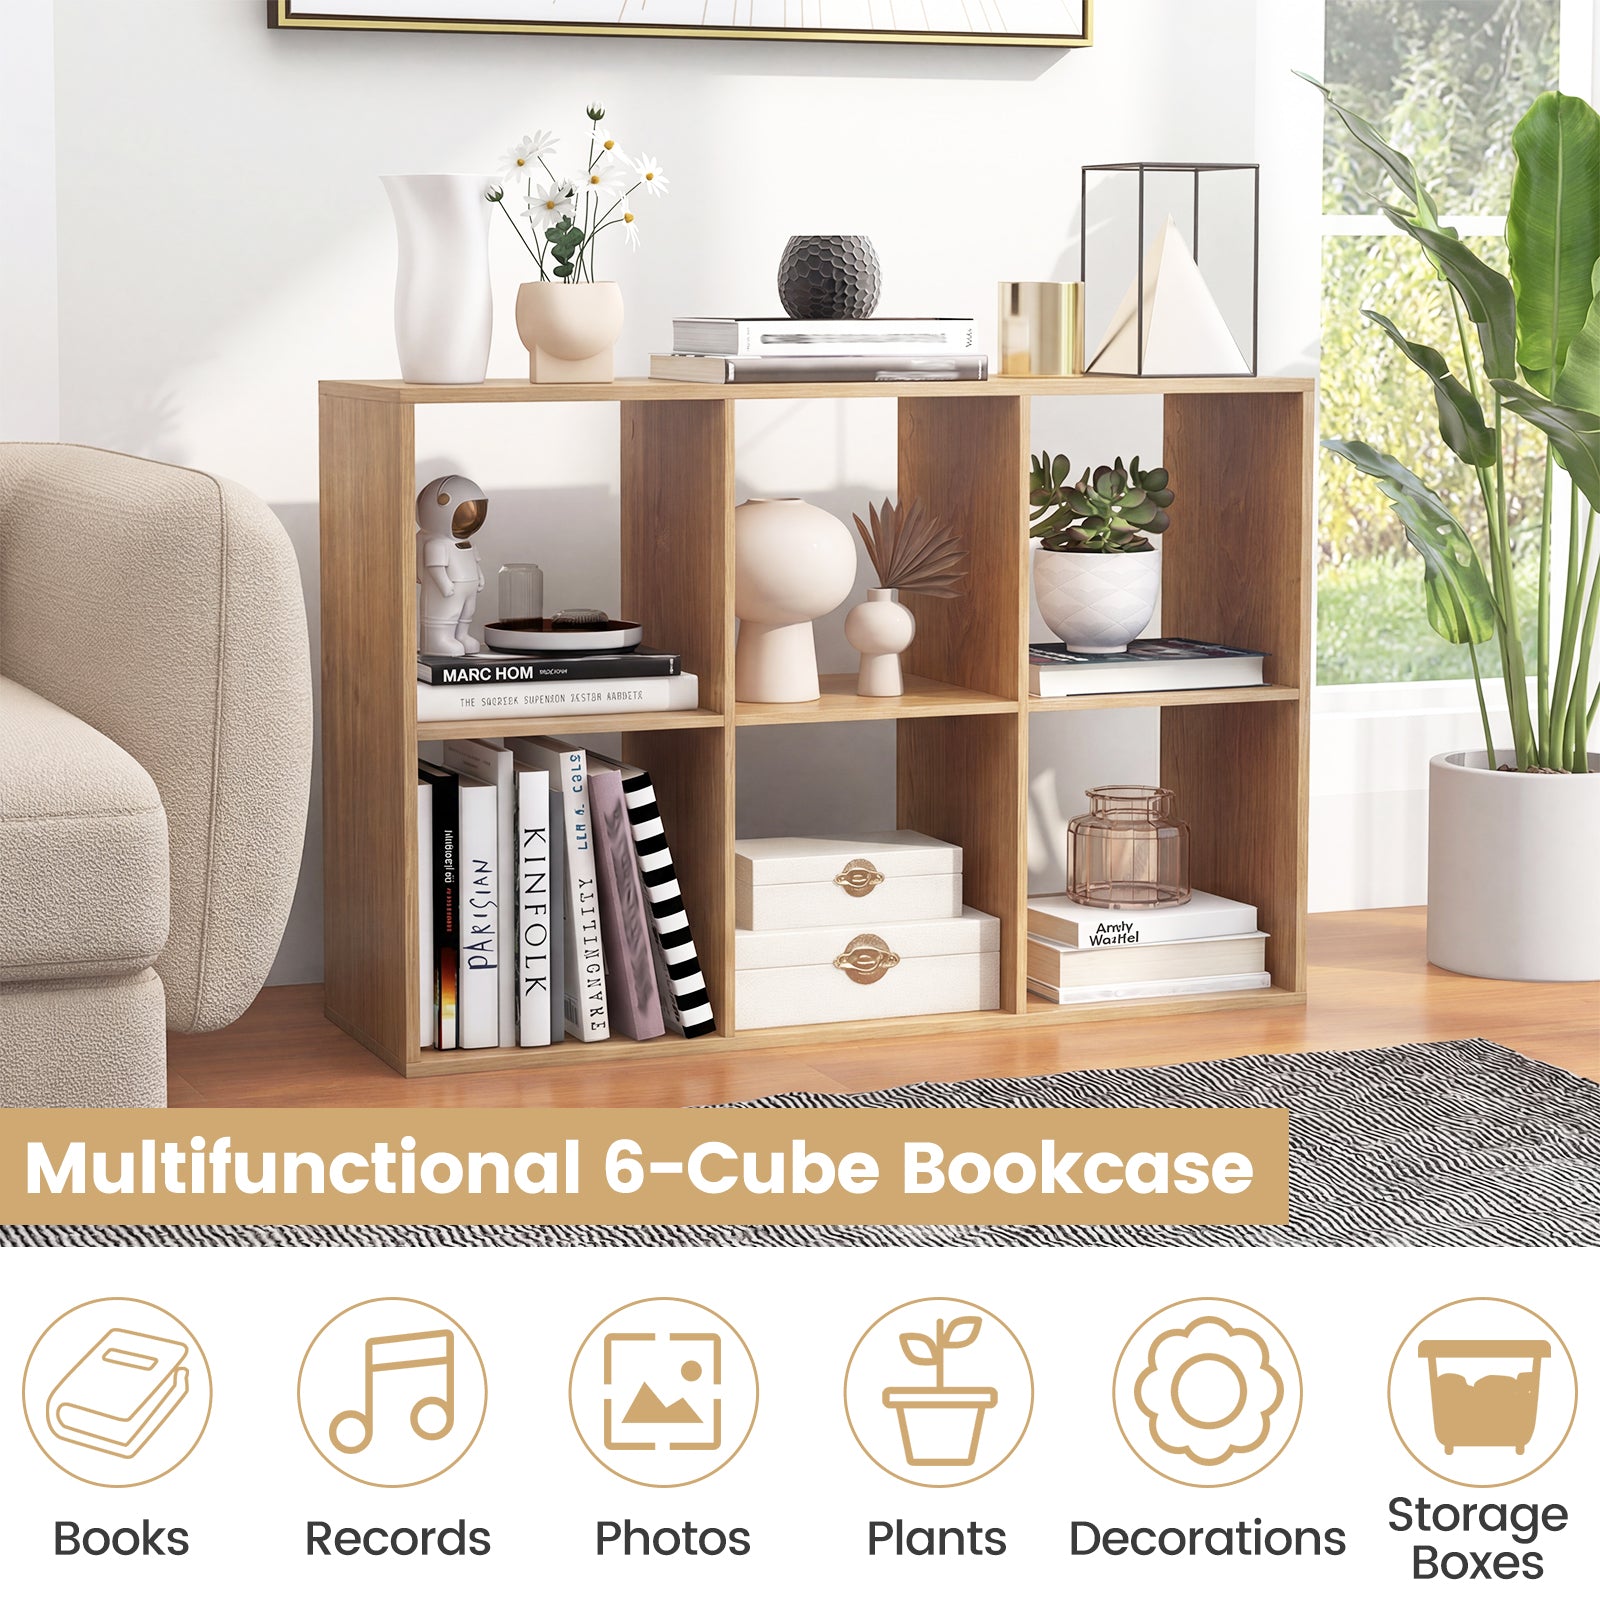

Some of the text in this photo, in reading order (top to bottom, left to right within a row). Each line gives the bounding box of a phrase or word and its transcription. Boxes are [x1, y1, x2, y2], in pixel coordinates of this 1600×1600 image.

[443, 666, 492, 683] MARC
[495, 665, 534, 681] HOM
[460, 697, 476, 708] THE
[468, 859, 498, 970] PARISIAN
[523, 827, 549, 997] KINFOLK
